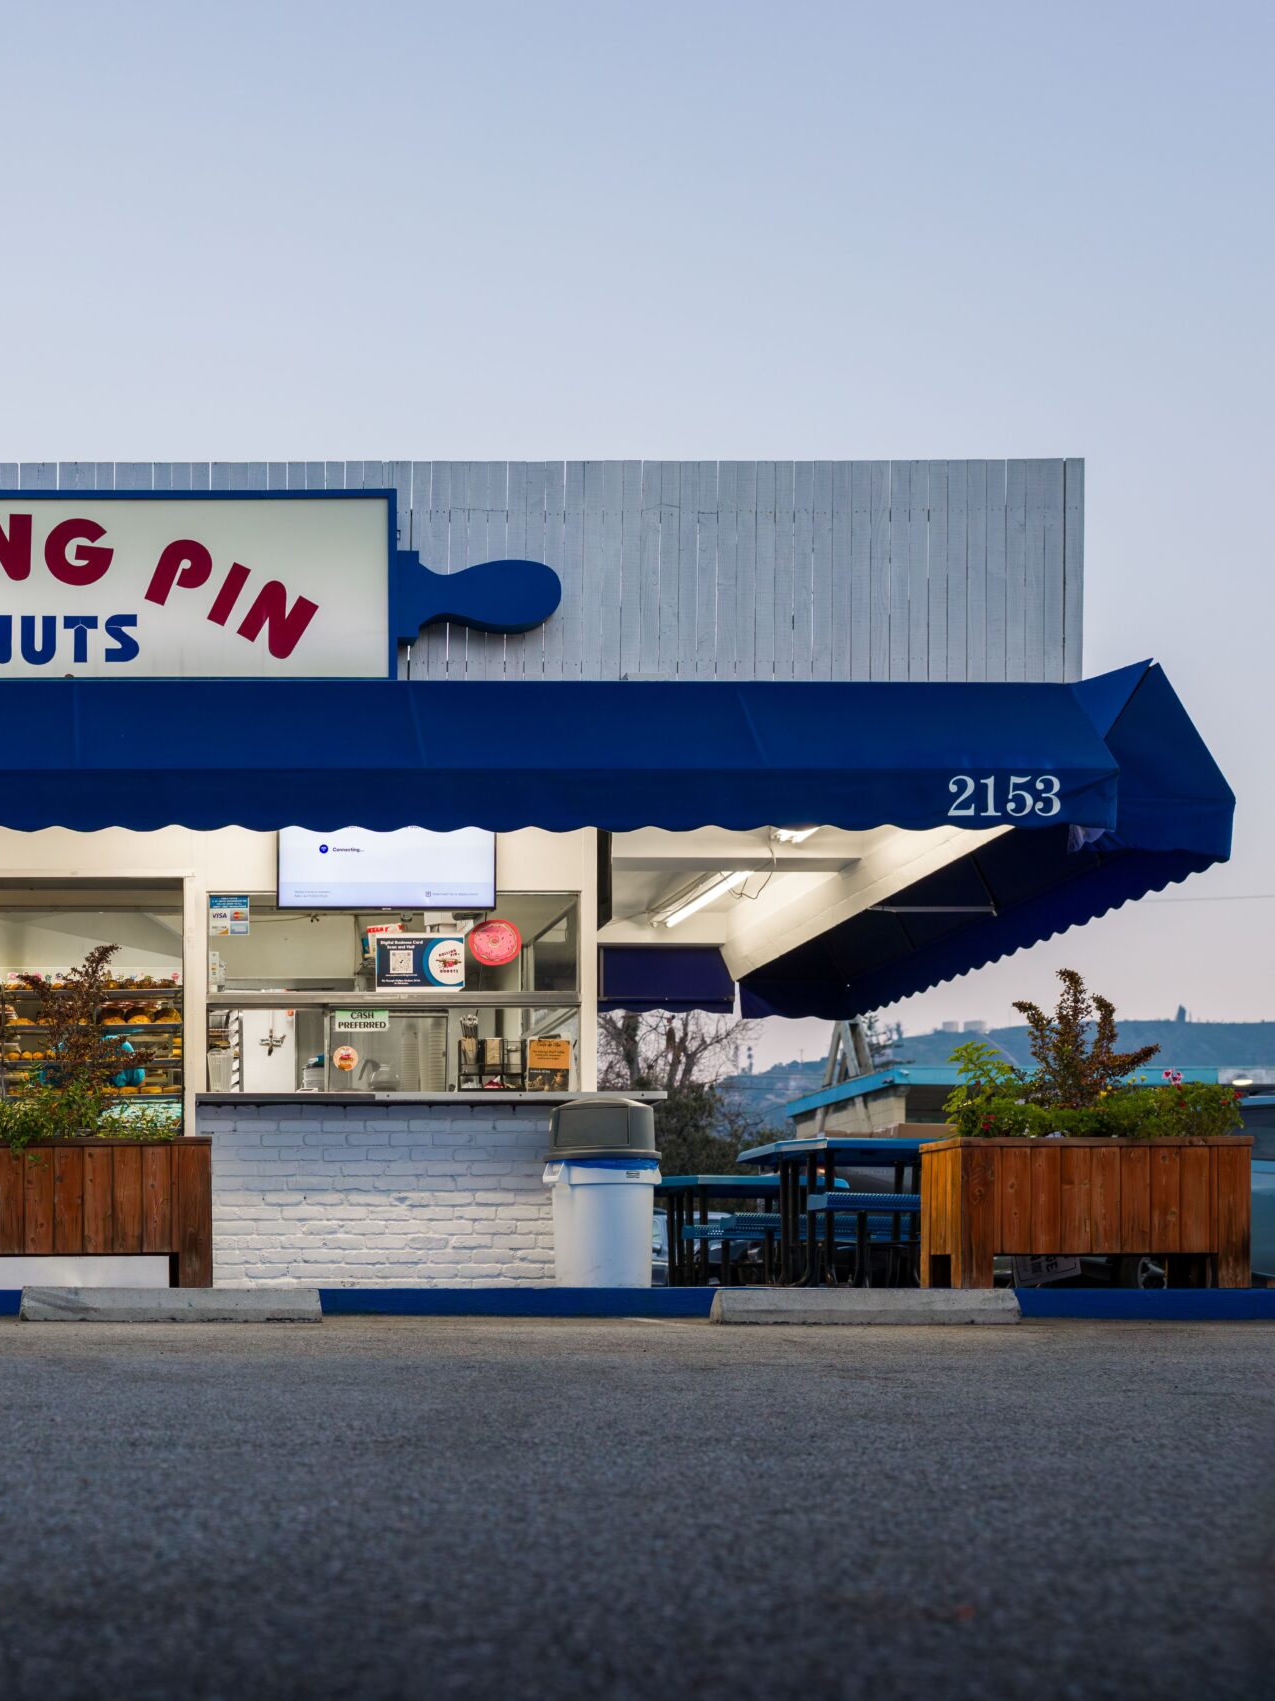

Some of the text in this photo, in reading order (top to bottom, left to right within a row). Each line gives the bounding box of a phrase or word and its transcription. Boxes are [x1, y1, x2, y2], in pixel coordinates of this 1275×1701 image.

[145, 540, 319, 659] PIN
[947, 775, 1061, 816] 2153
[338, 1021, 386, 1029] PREFERRED
[350, 1011, 374, 1019] CASH
